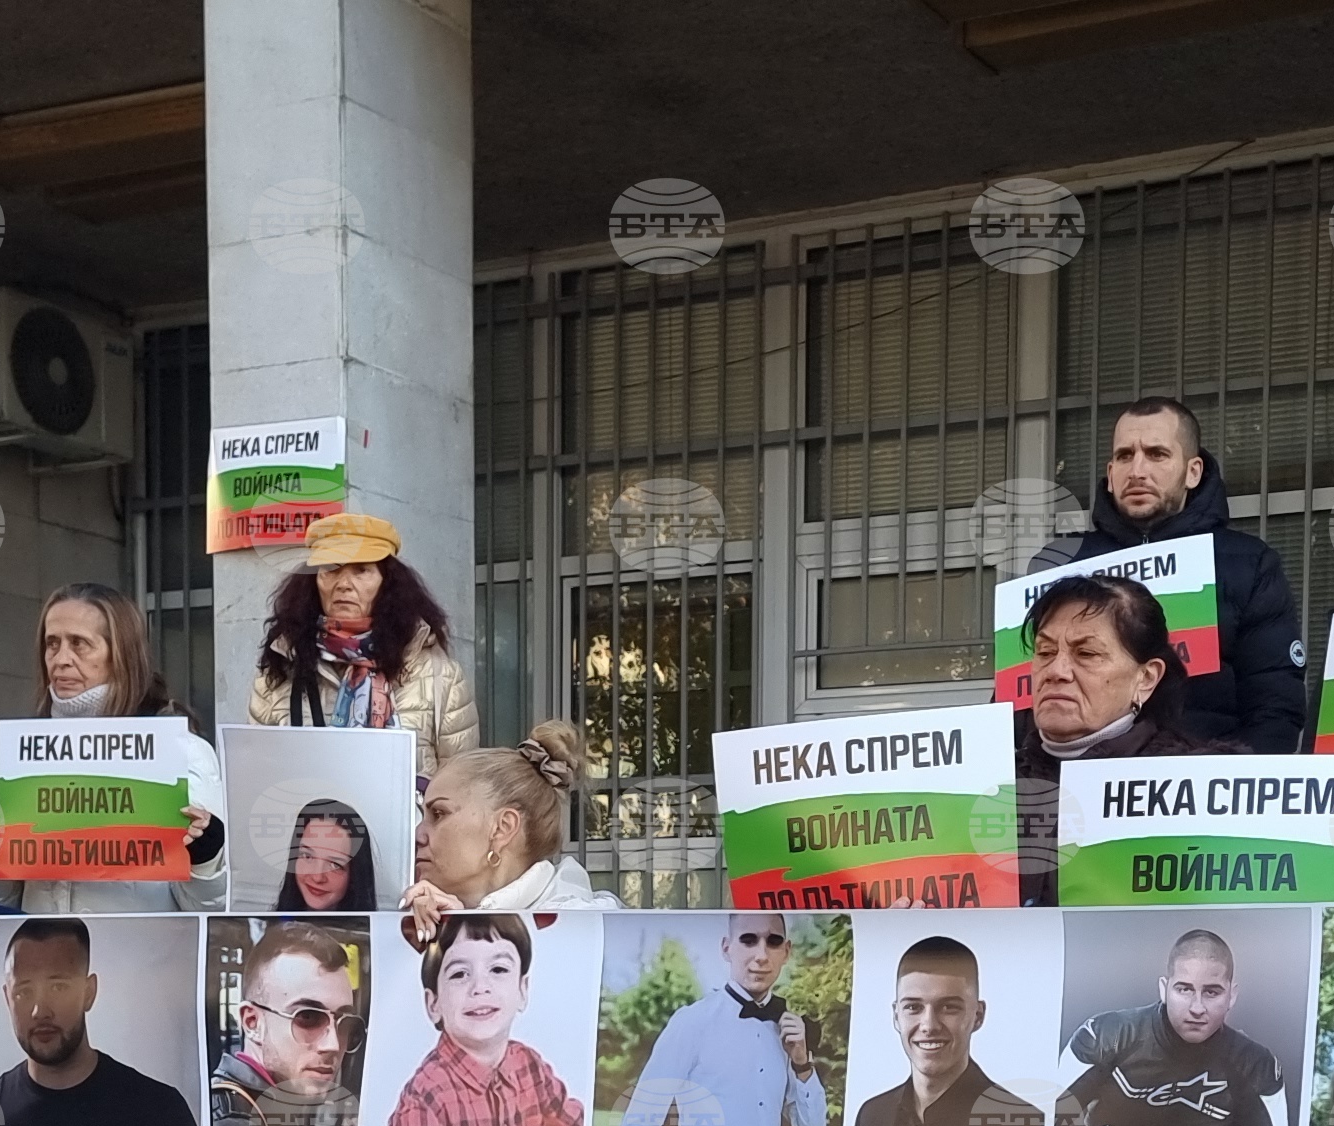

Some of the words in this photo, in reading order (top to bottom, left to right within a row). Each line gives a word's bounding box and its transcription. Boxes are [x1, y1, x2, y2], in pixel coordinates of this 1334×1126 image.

[221, 437, 260, 460] НЕКА
[265, 431, 319, 455] СПРЕМ
[234, 472, 302, 498] ВОЙНАТА
[217, 518, 234, 540] ПО
[19, 735, 73, 761] НЕКА
[80, 733, 154, 760] СПРЕМ
[753, 742, 837, 785] НЕКА
[845, 729, 962, 774] СПРЕМ
[37, 782, 134, 813] ВОЙНАТА
[1103, 779, 1196, 818] НЕКА
[787, 804, 934, 853] ВОЙНАТА
[9, 839, 37, 865] ПО
[43, 839, 165, 866] ПЪТИЩАТА
[1132, 846, 1297, 893] ВОЙНАТА
